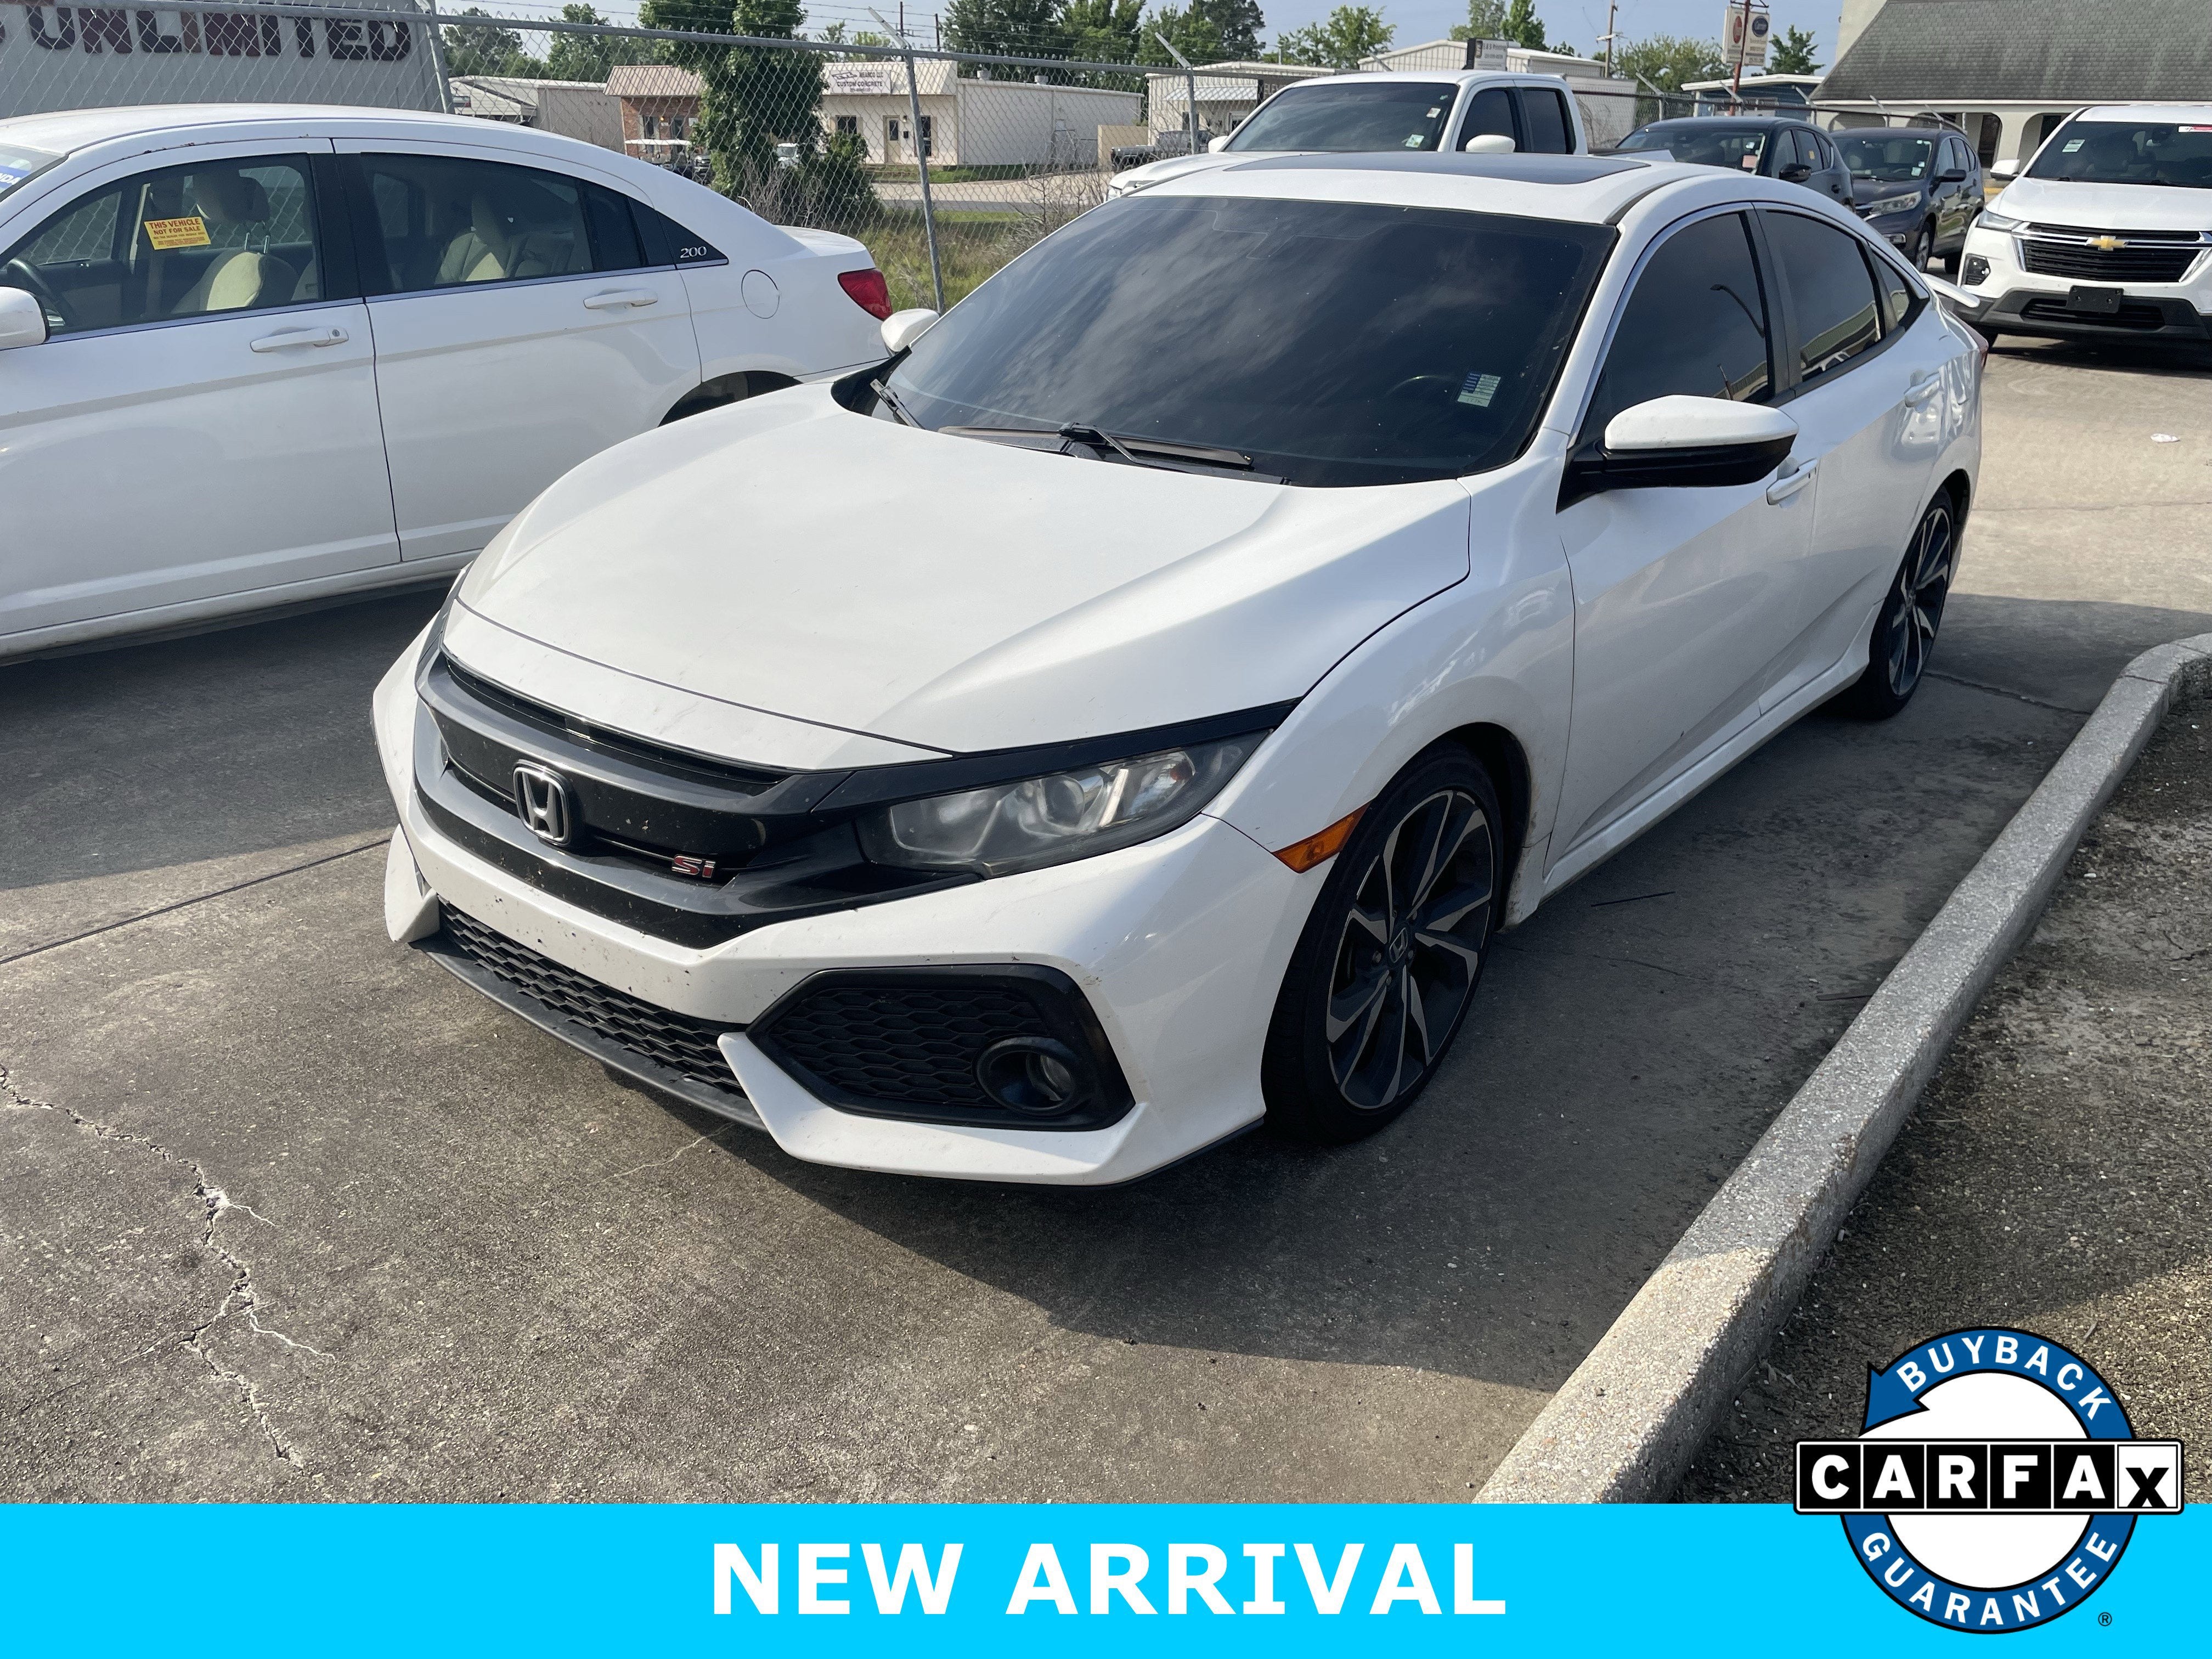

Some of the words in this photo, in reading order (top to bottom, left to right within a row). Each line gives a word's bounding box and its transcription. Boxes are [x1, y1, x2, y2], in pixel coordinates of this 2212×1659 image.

[26, 3, 410, 61] UNLIMITED
[149, 221, 167, 229] THIS
[168, 218, 201, 228] VEHICLE
[680, 246, 707, 258] 200
[672, 855, 716, 878] Si
